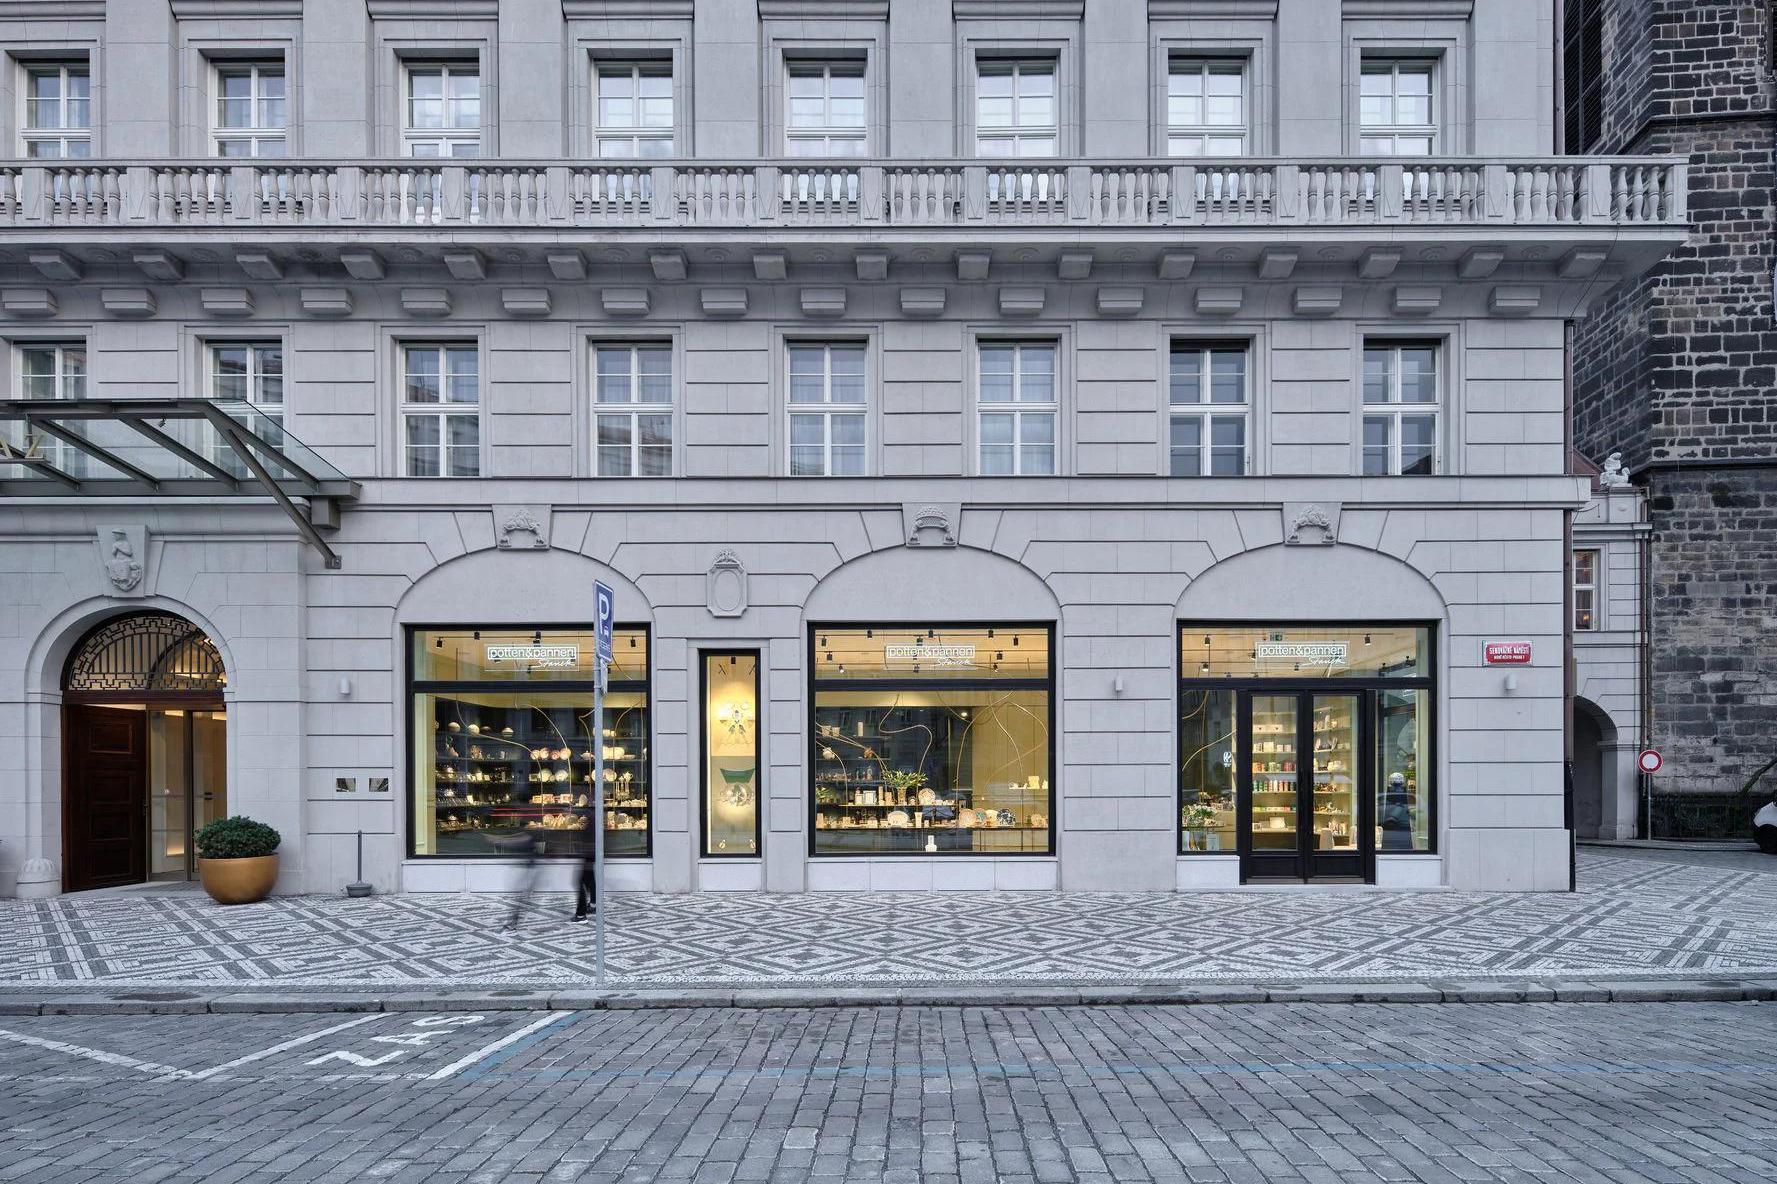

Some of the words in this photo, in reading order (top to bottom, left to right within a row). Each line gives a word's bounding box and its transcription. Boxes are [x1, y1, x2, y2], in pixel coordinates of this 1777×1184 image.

[599, 593, 609, 634] P
[489, 648, 574, 659] potten&pannen
[888, 647, 973, 658] potten&pannen
[1260, 646, 1345, 657] potten&pannen
